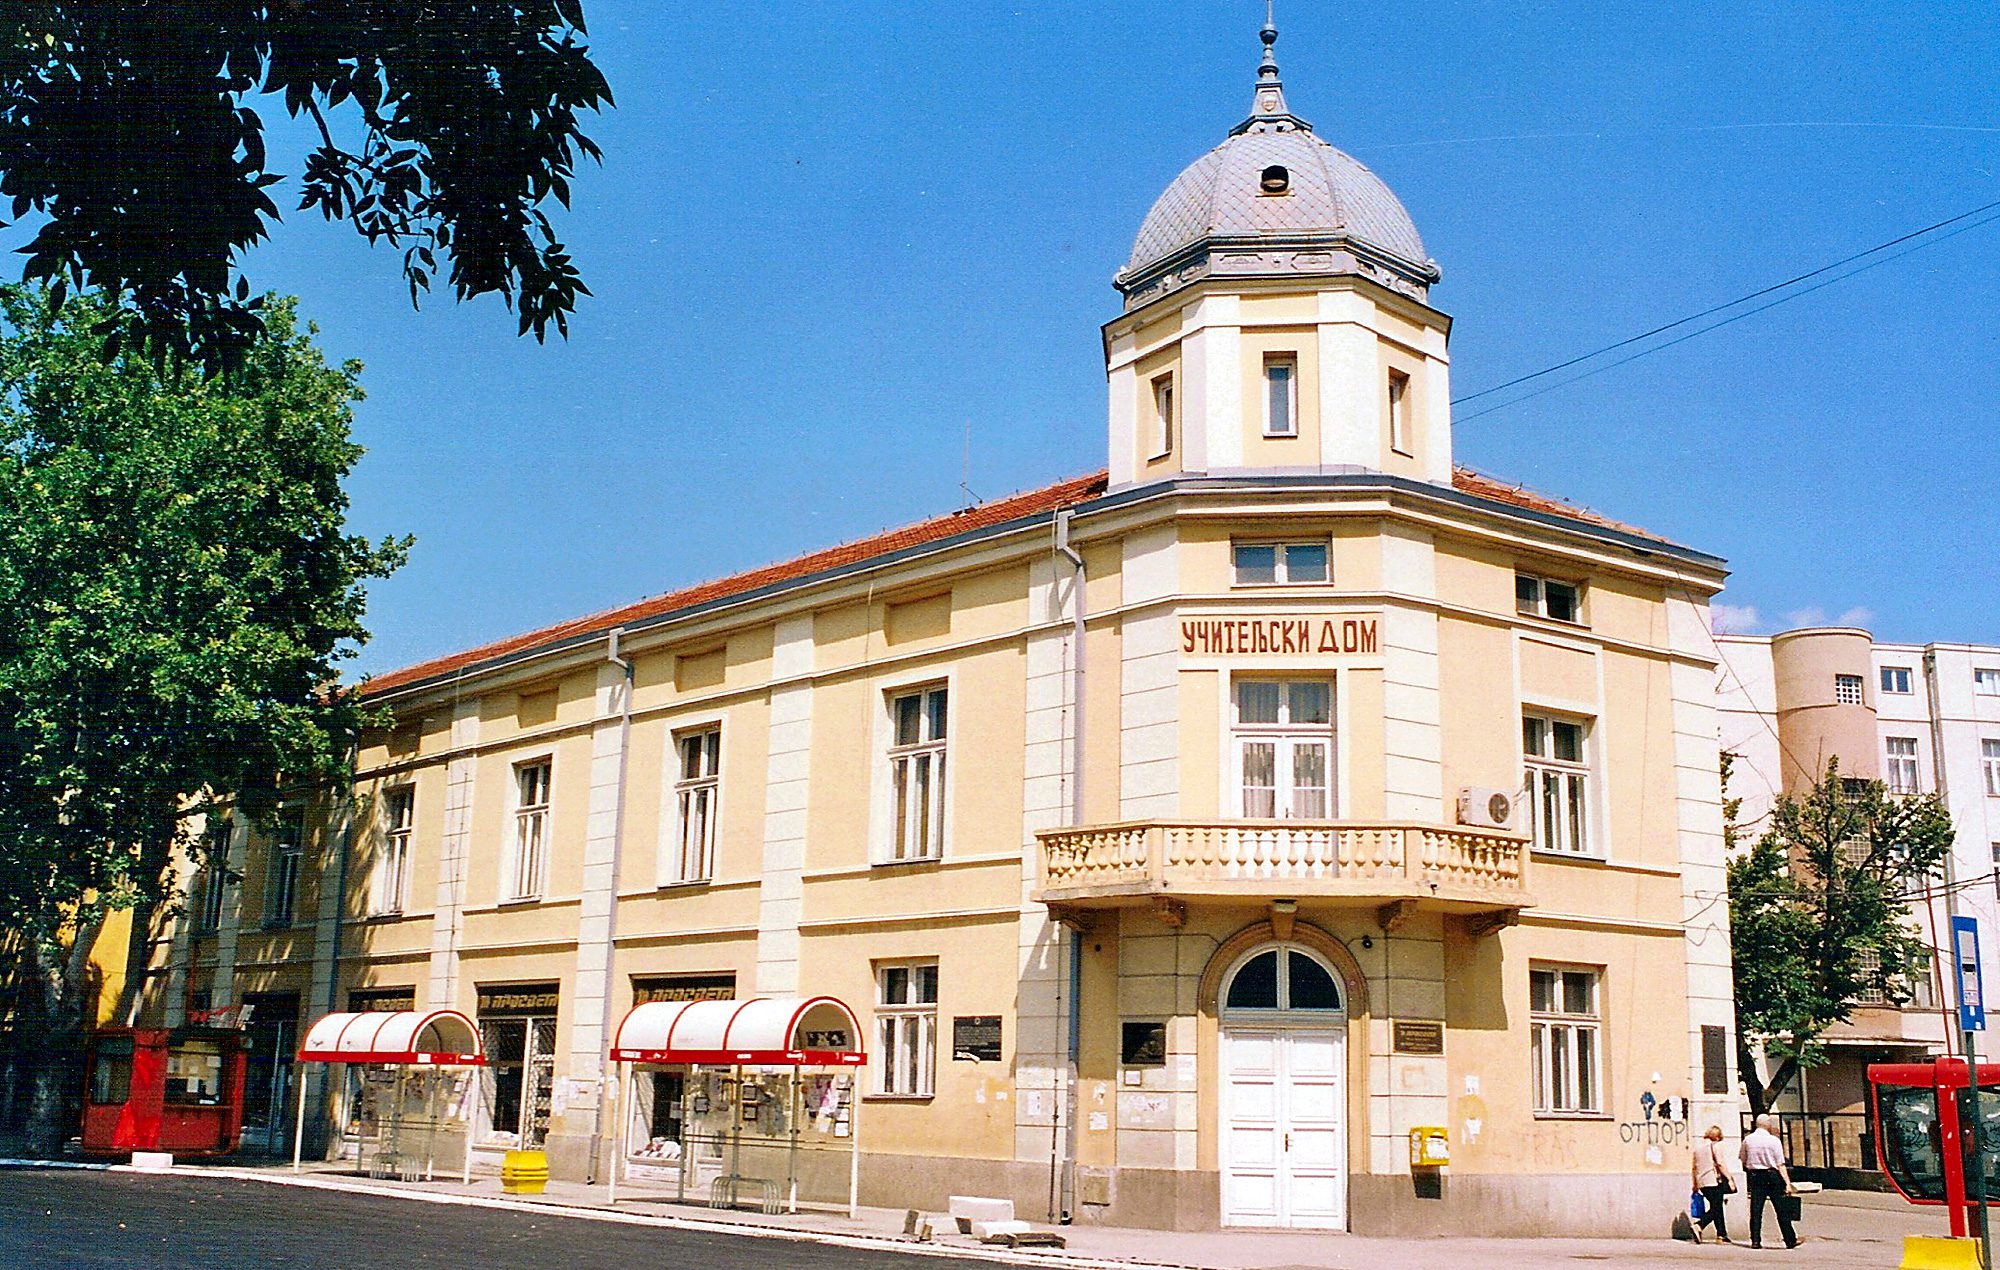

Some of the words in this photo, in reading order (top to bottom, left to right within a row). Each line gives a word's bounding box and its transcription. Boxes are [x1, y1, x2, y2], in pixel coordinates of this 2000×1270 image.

[1181, 620, 1309, 654] УЧИТЕЉСКИ
[1317, 620, 1377, 653] ДОМ
[1619, 1121, 1690, 1150] ОТПОР!
